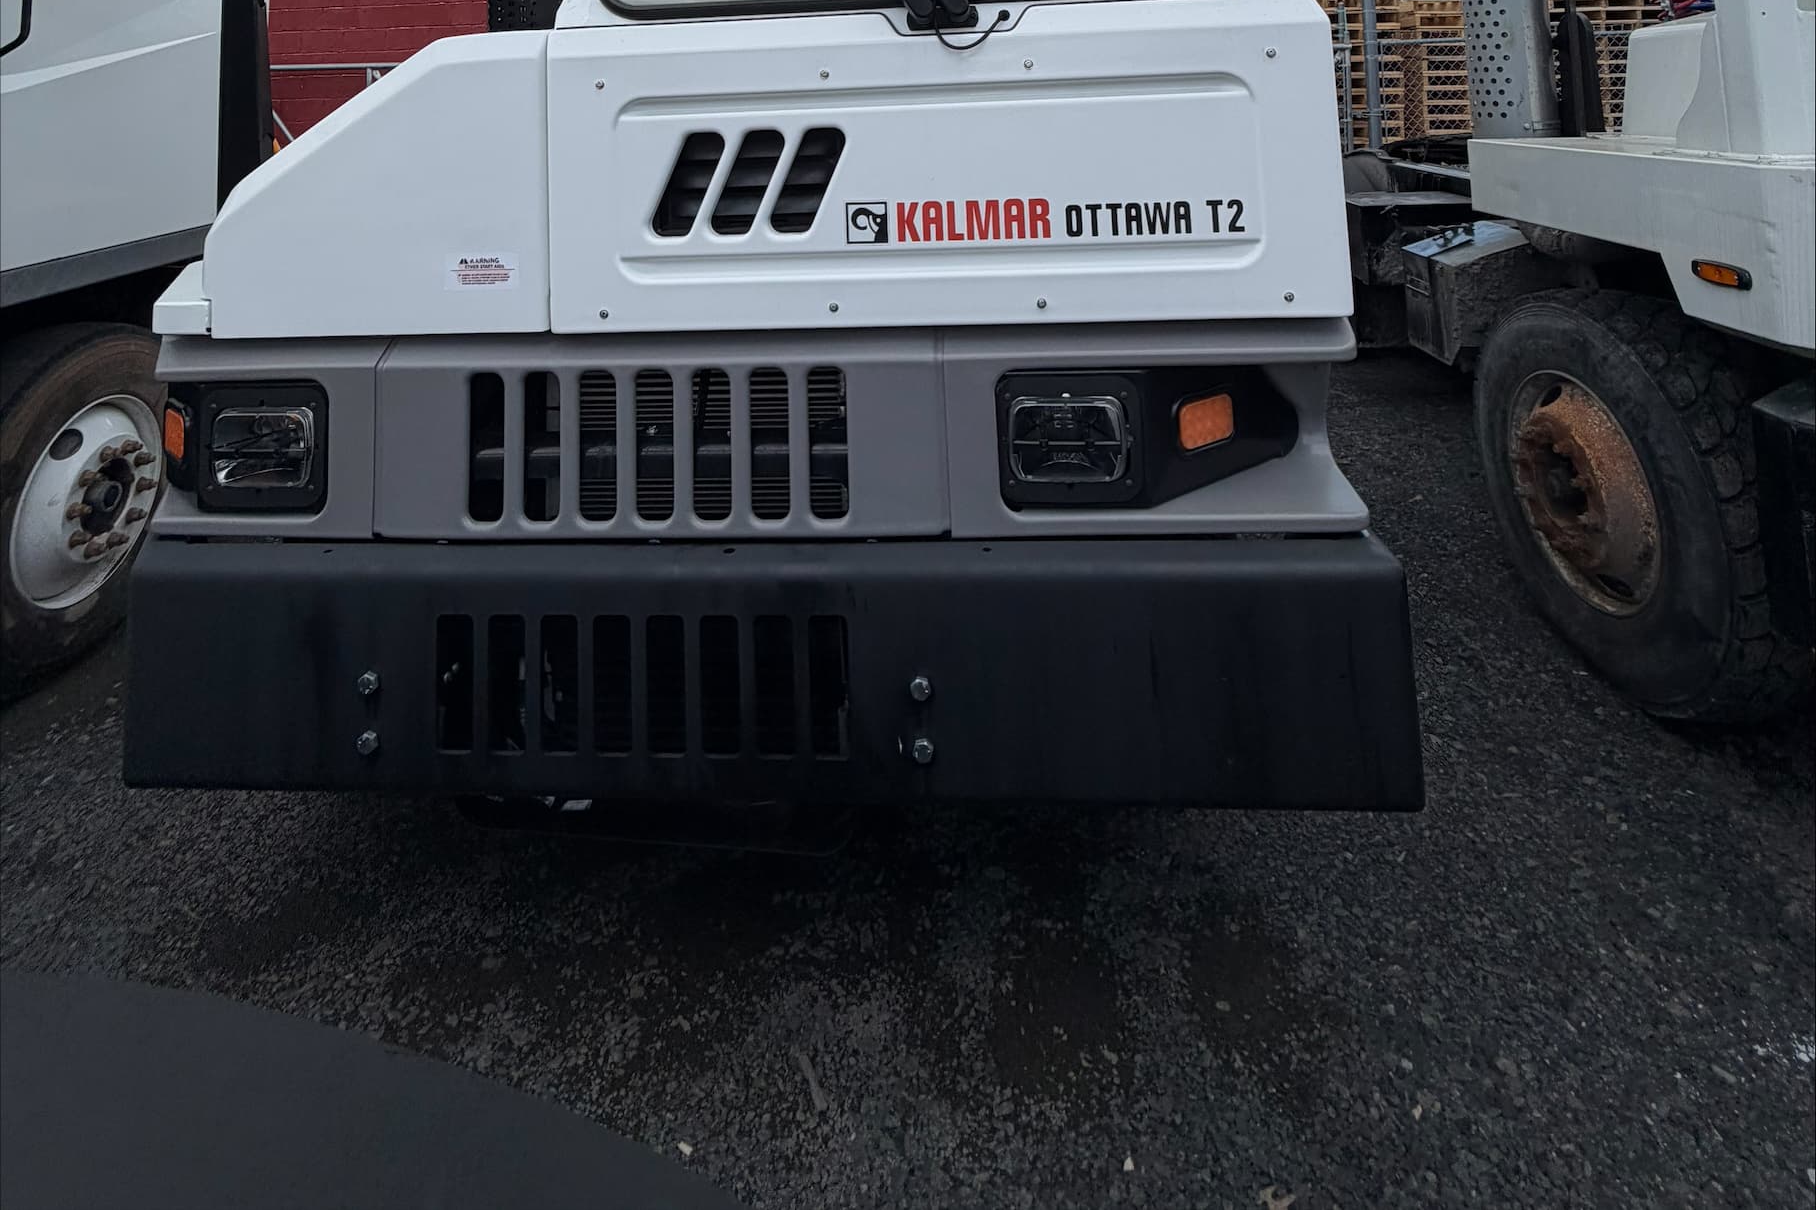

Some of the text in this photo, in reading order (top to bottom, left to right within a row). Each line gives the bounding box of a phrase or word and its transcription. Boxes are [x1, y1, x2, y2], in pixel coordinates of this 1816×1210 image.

[896, 198, 1245, 242] KALMAR OTTAWA T2
